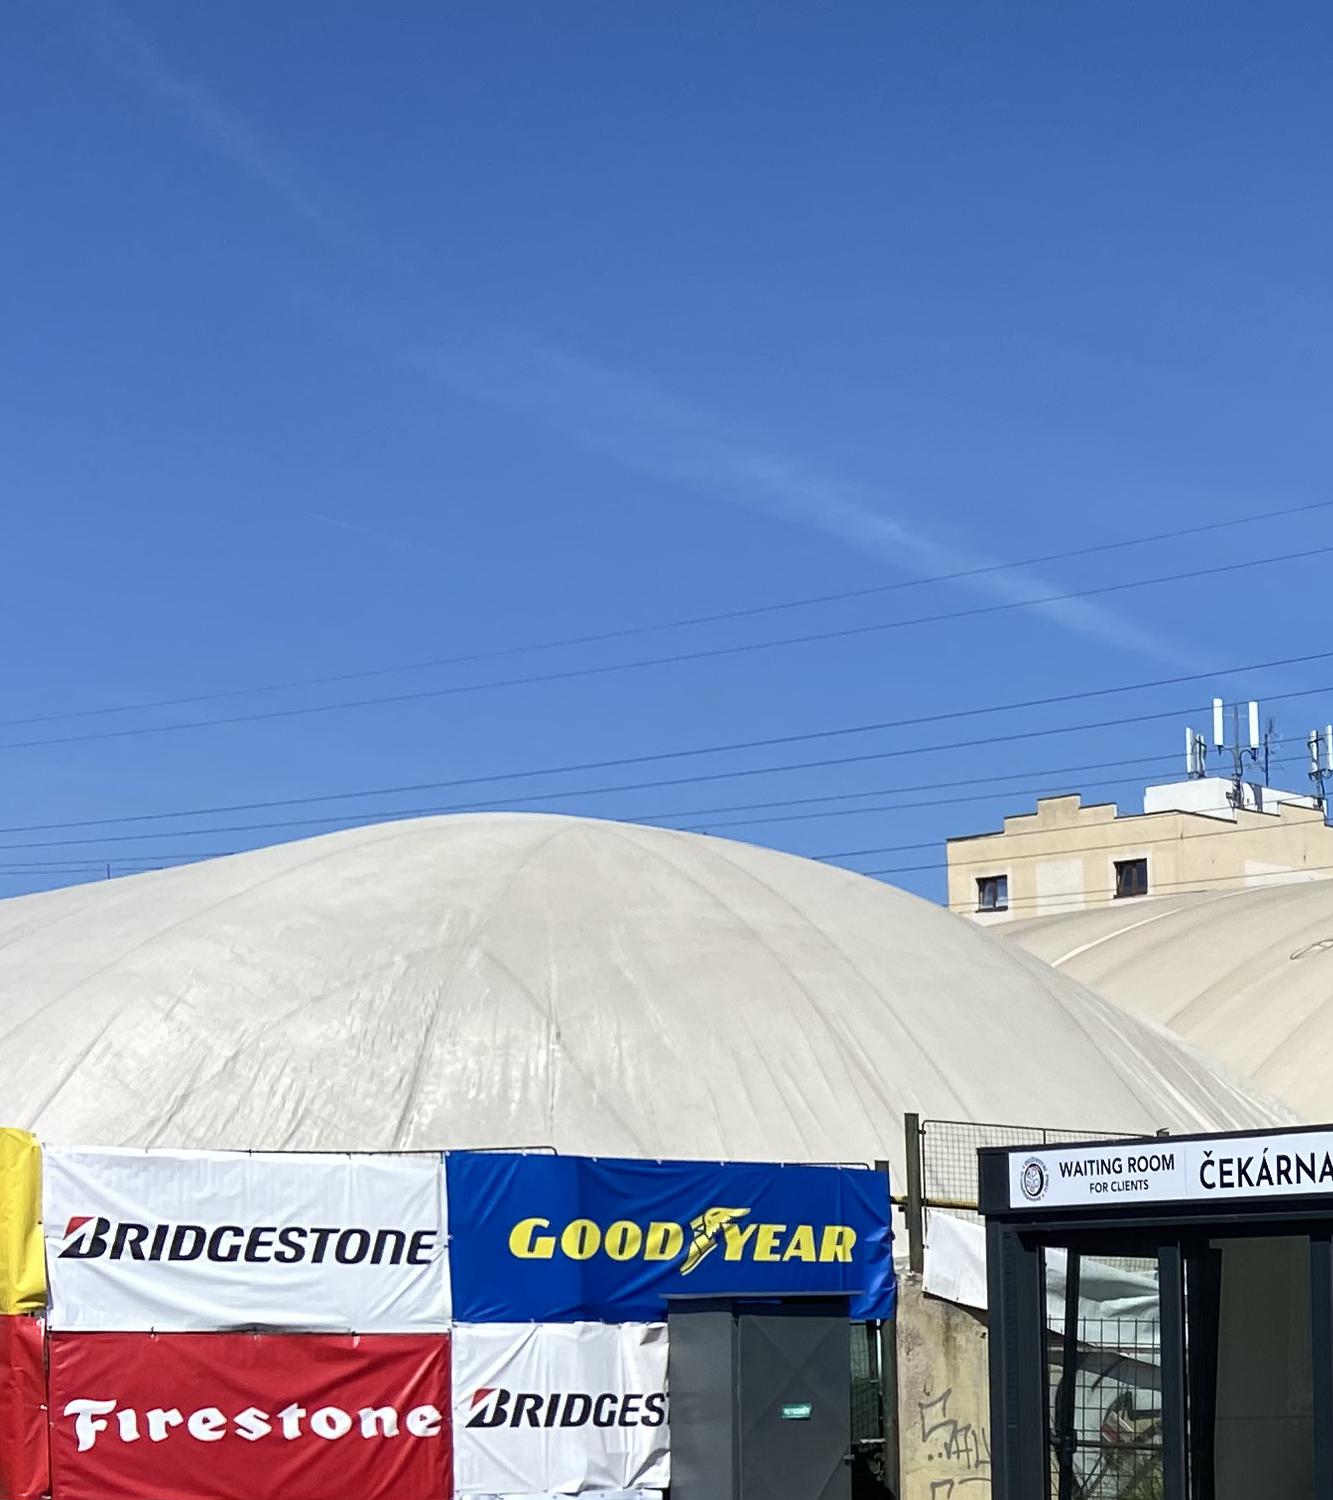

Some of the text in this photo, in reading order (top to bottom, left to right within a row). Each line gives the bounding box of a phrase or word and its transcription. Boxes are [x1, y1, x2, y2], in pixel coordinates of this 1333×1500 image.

[1059, 1154, 1175, 1178] WAITING ROOM
[1089, 1179, 1149, 1194] FOR CLIENTS
[58, 1216, 438, 1265] BRIDGESTONE
[64, 1398, 442, 1452] Firestone
[465, 1388, 671, 1428] BRIDGES
